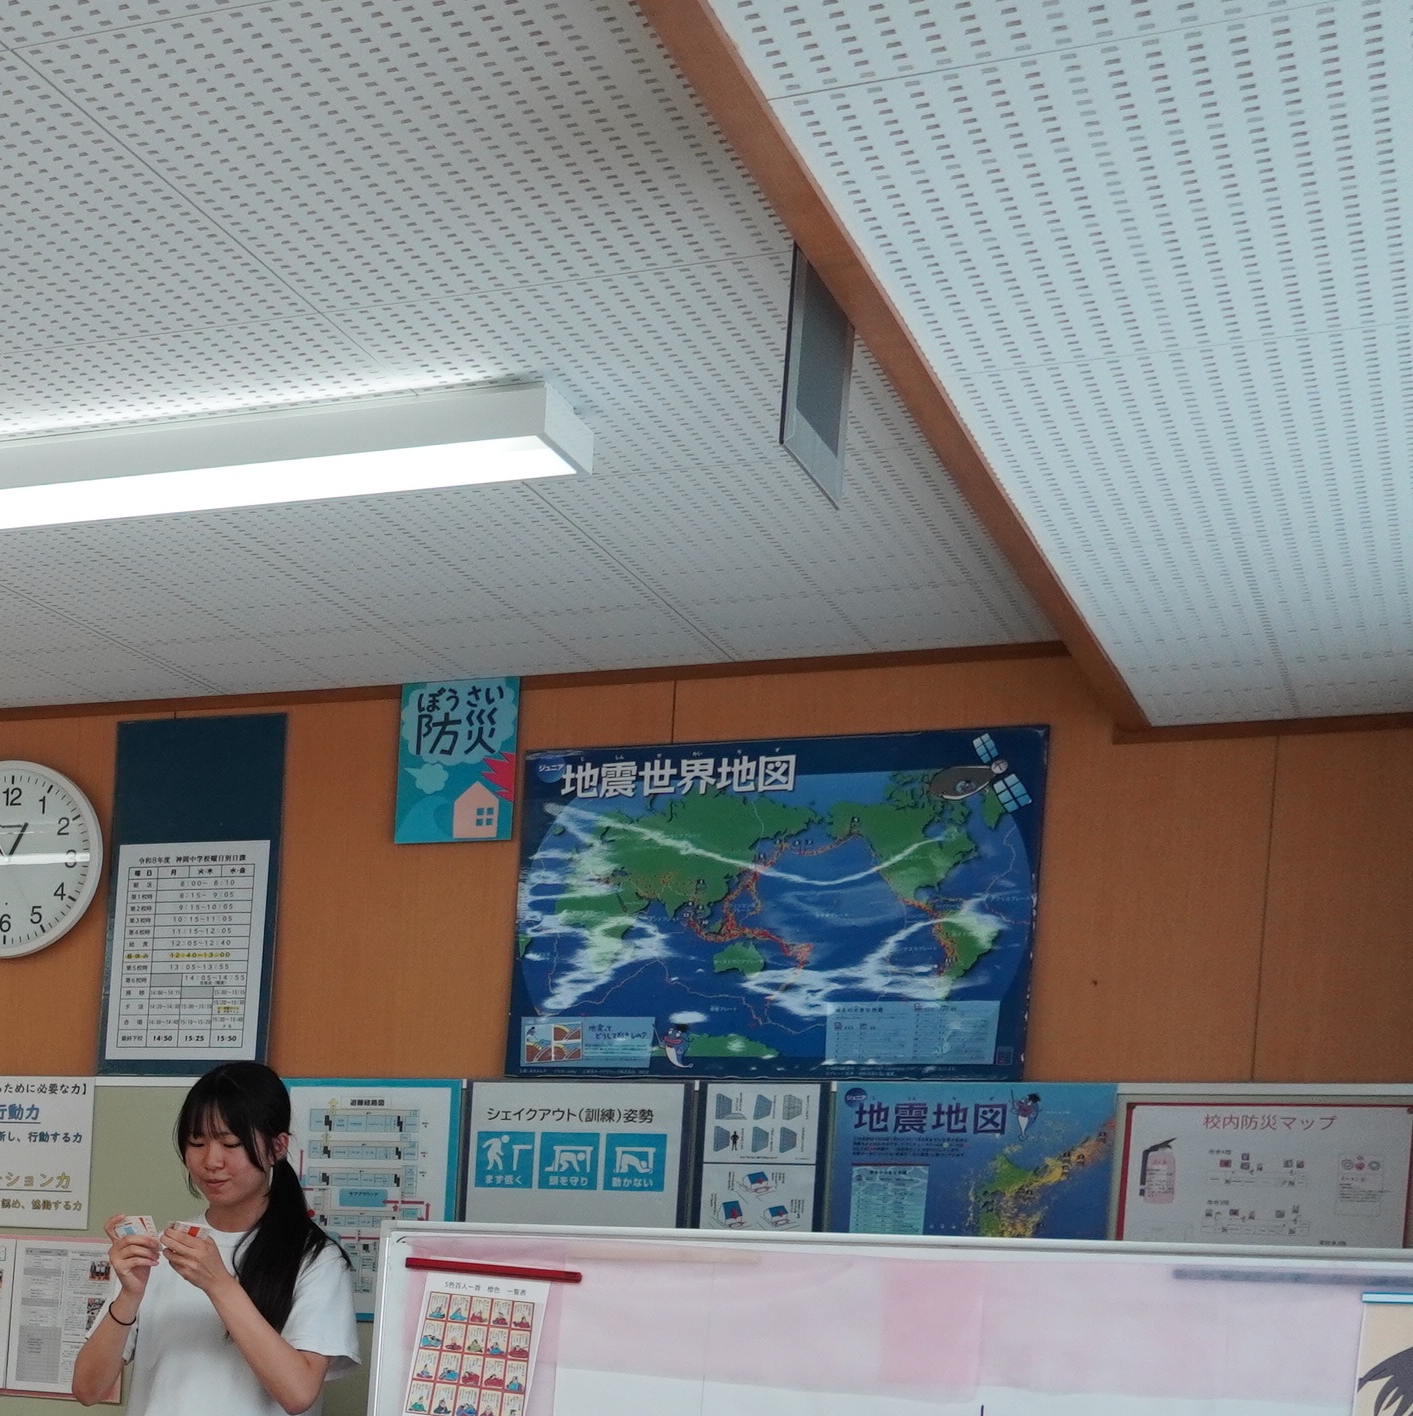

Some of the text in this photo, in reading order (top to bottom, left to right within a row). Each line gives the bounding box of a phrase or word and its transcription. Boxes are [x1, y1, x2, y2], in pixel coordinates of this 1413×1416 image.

[418, 685, 505, 713] ぼうさい
[415, 711, 498, 756] 防災
[560, 754, 796, 798] 地震世界地図
[2, 788, 22, 806] 12
[39, 796, 45, 814] 1
[57, 817, 69, 835] 2
[54, 883, 66, 900] 4
[0, 914, 11, 932] 6
[30, 906, 42, 923] 5
[486, 1106, 653, 1124] シェイクアウト(訓練)姿勢
[854, 1103, 1007, 1135] 地震地図
[1203, 1113, 1337, 1132] 校内防災マップ
[484, 1173, 523, 1186] まず低く
[548, 1174, 589, 1187] 頭を守り
[611, 1176, 653, 1188] 動かない
